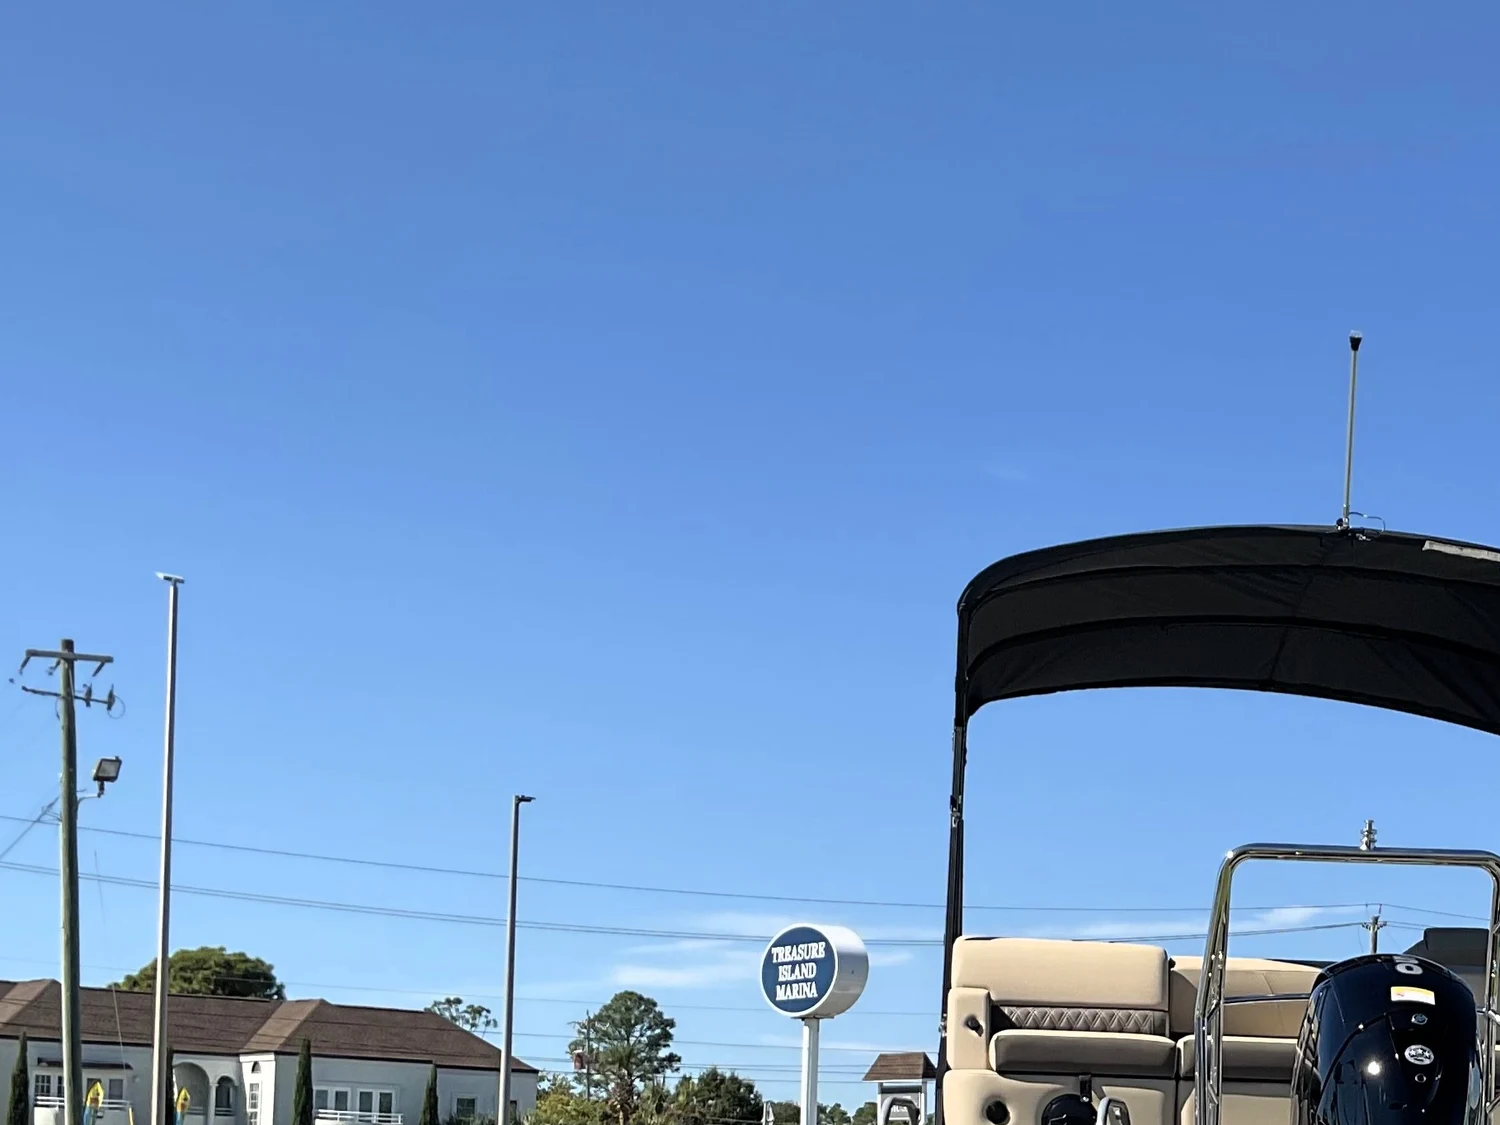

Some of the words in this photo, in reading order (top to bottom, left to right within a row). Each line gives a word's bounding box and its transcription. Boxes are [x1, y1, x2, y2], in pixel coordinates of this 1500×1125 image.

[771, 941, 826, 963] TREASURE
[778, 962, 817, 981] ISLAND
[775, 981, 819, 1001] MARINA
